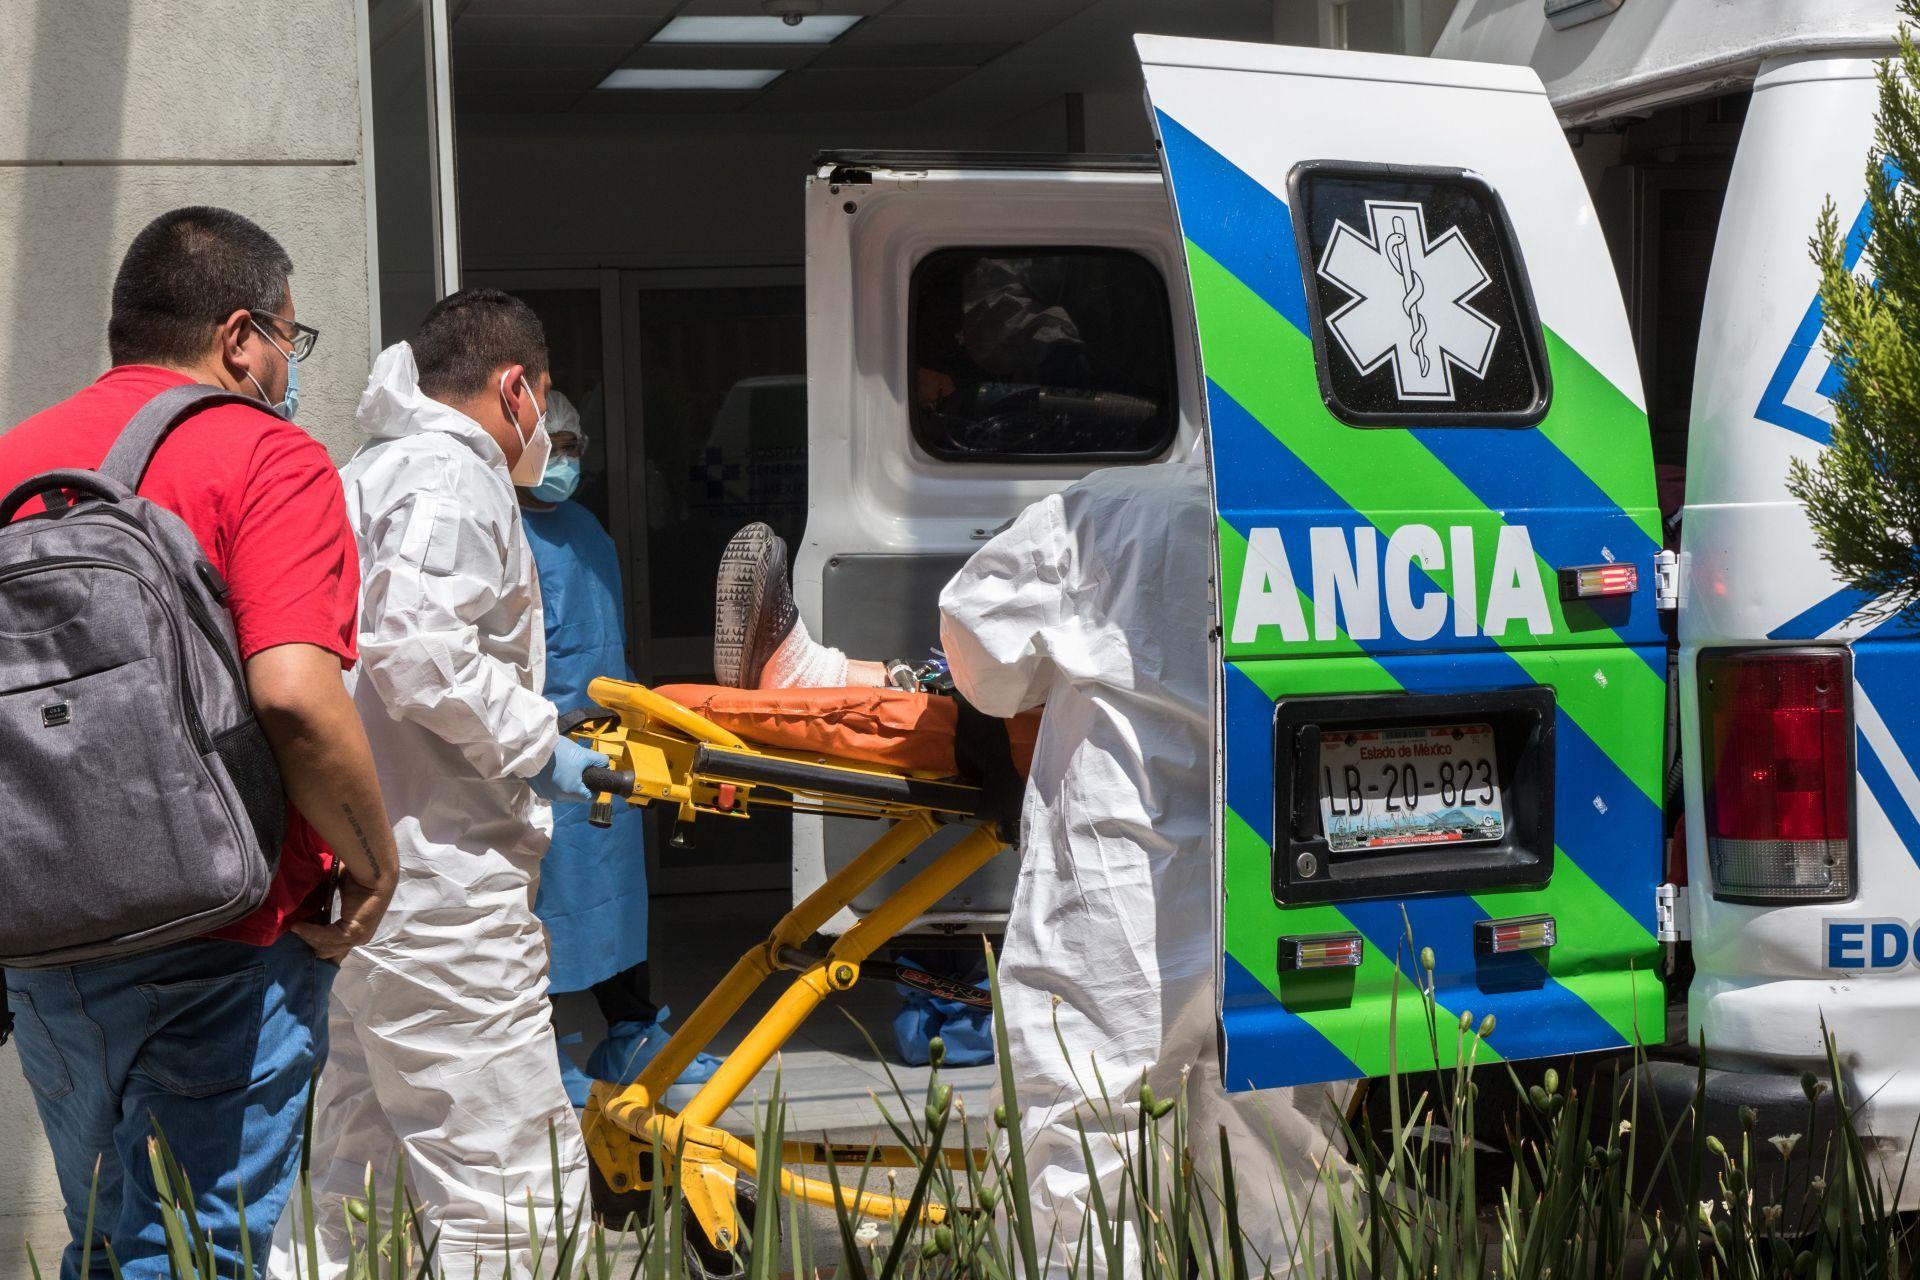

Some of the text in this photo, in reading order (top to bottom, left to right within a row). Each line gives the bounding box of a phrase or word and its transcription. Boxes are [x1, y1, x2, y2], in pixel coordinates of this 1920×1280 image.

[745, 446, 806, 458] HOSPITA
[746, 464, 806, 476] GENERA
[1231, 524, 1553, 643] ANCIA
[1360, 743, 1452, 760] Estado de México
[1323, 758, 1495, 817] LB-20-823
[1828, 923, 1920, 968] ED
